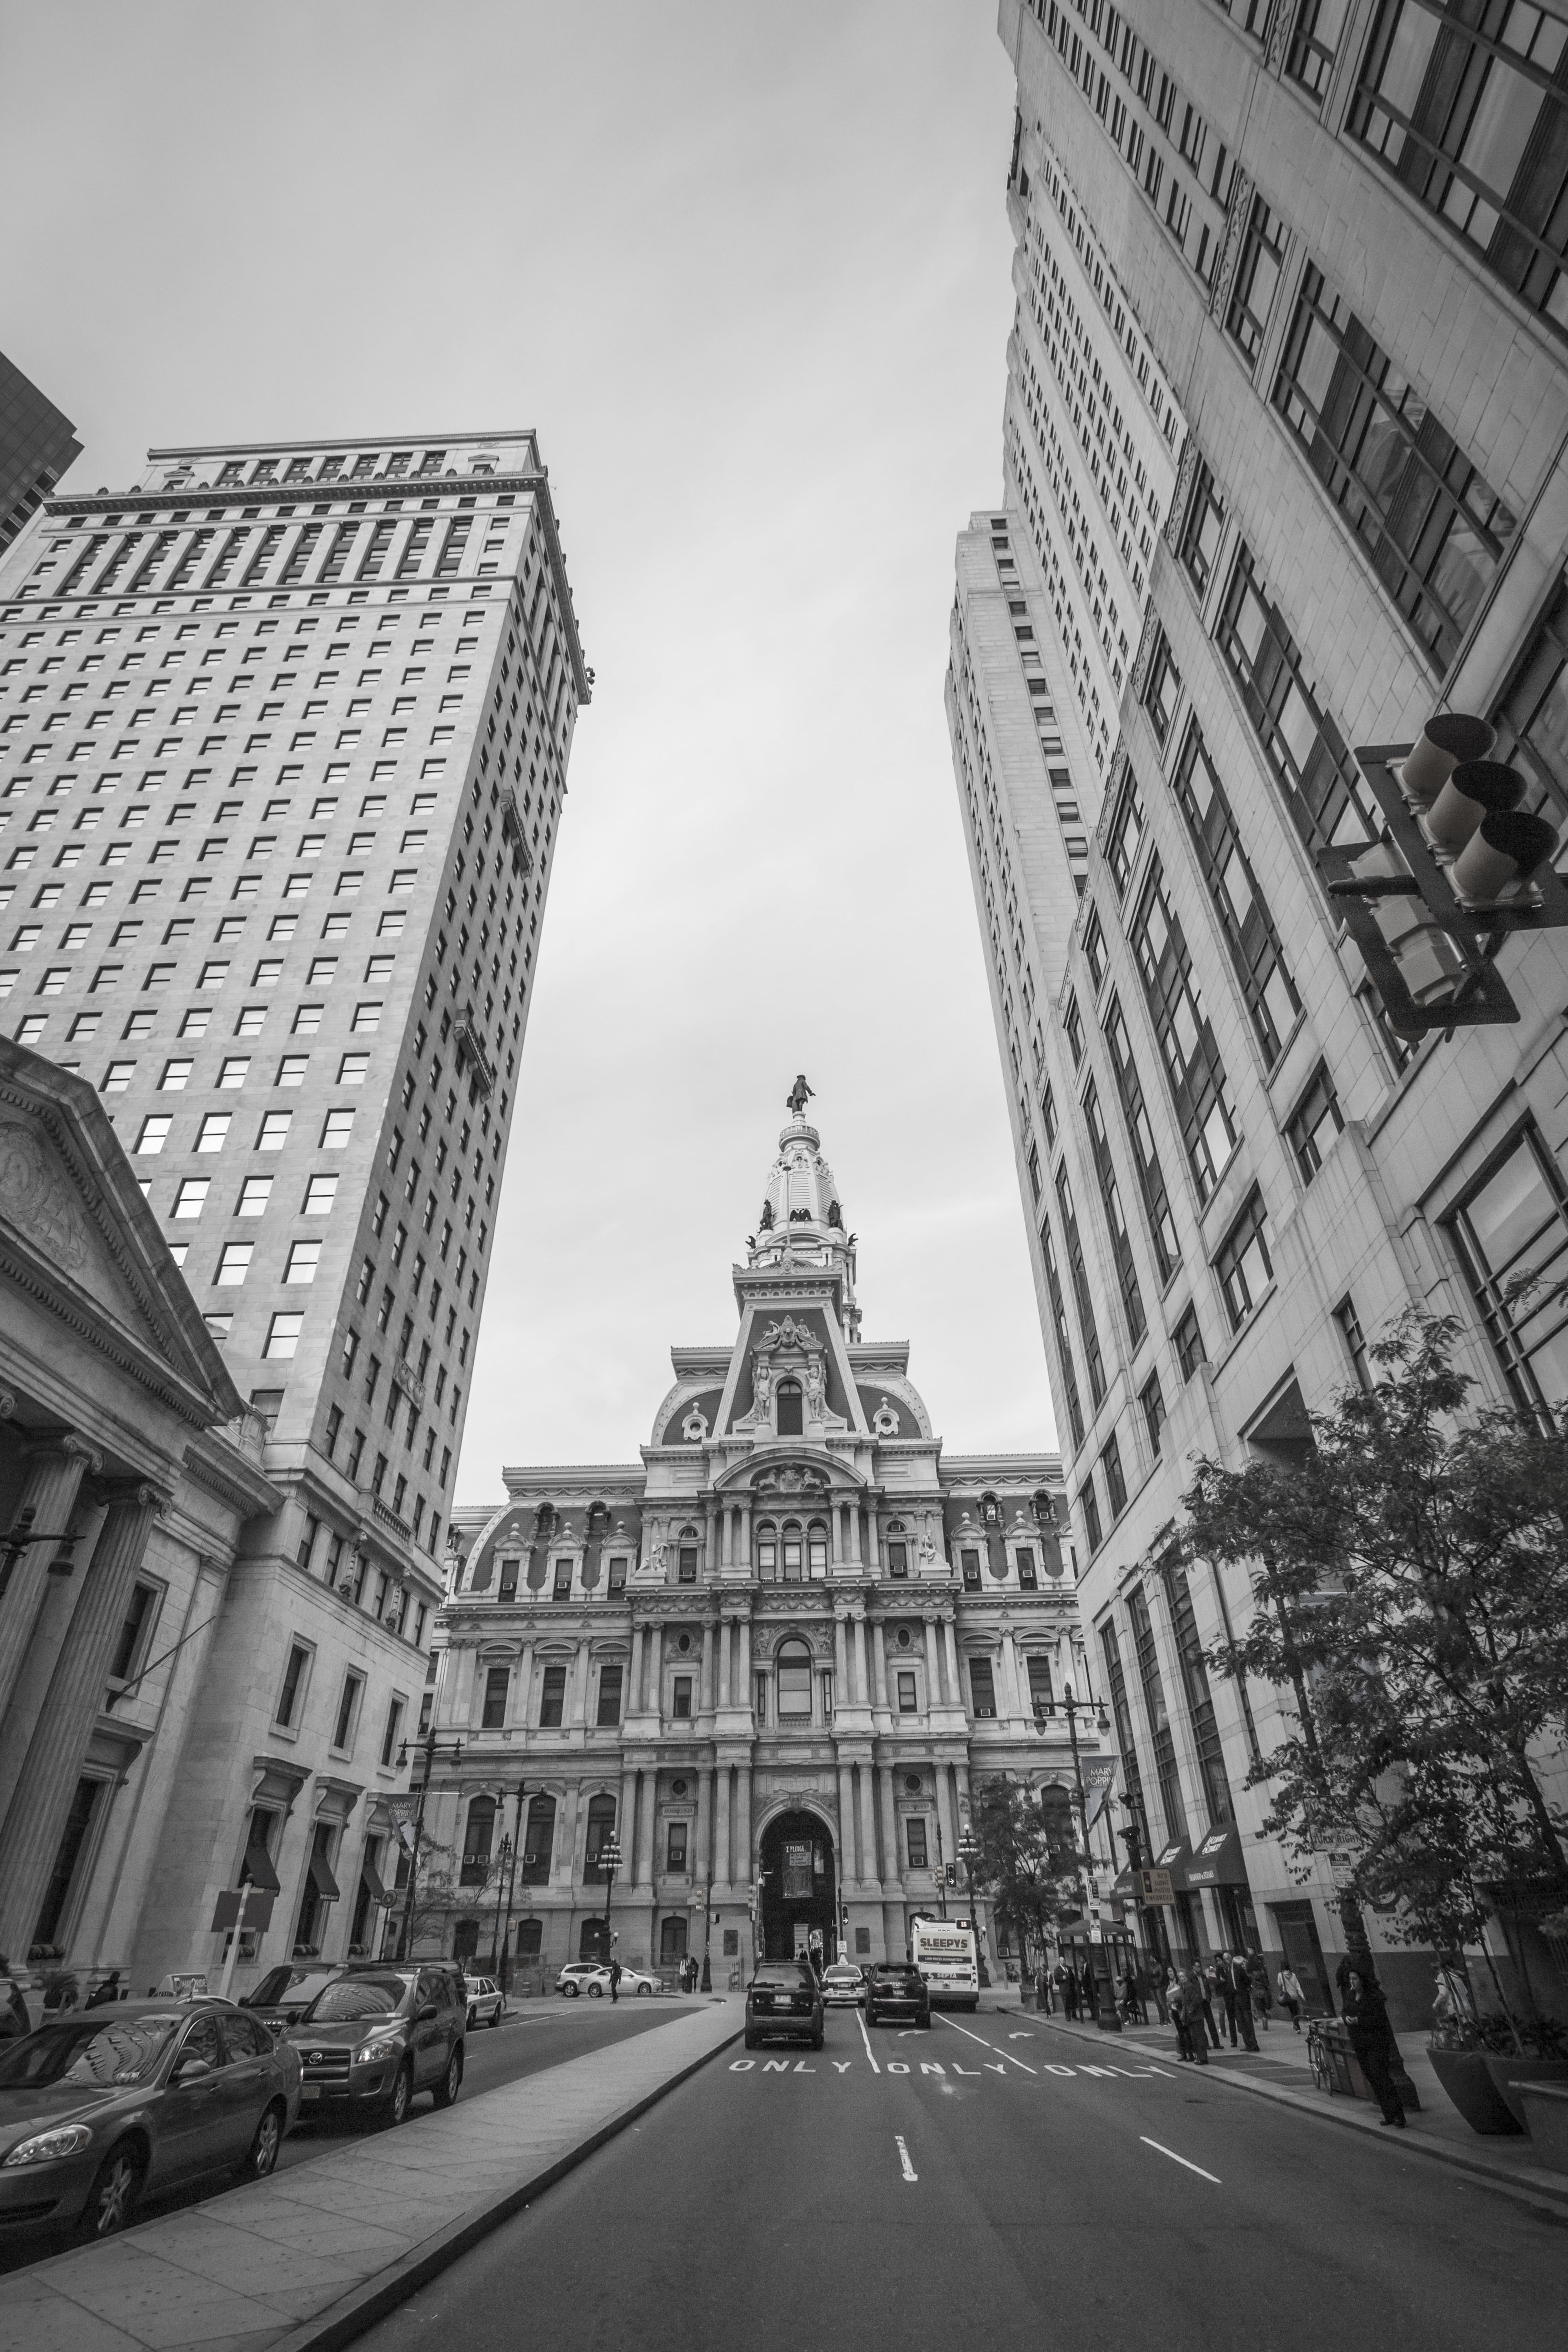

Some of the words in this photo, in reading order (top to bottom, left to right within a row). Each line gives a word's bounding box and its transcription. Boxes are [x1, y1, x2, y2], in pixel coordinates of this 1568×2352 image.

[1090, 1767, 1112, 1776] MARY
[1086, 1776, 1114, 1785] POPPIN
[1313, 1833, 1333, 1844] TURN
[1336, 1834, 1359, 1843] RIGHT
[729, 2060, 851, 2072] ONLY
[887, 2063, 1007, 2075] ONLY
[1043, 2064, 1178, 2077] ONLY
